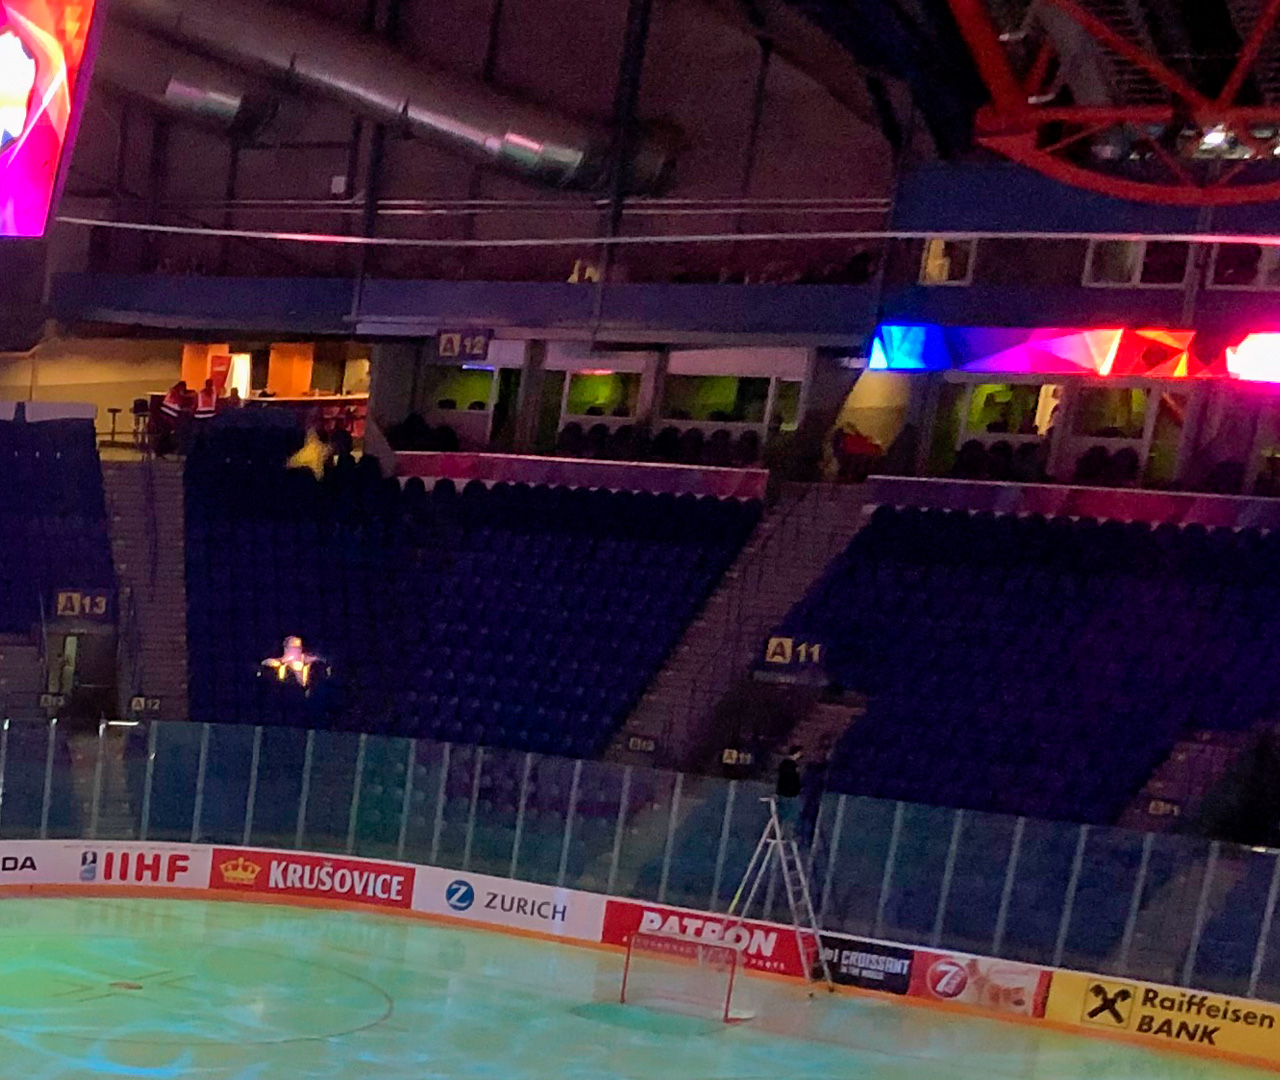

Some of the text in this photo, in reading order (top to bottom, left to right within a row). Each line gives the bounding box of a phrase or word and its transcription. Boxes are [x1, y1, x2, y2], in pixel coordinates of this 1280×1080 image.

[103, 851, 190, 882] IIHF
[268, 860, 404, 901] KRUŠOVICE
[483, 891, 567, 922] ZURICH
[1142, 988, 1275, 1028] Raiffeisen
[1136, 1015, 1221, 1045] BANK
